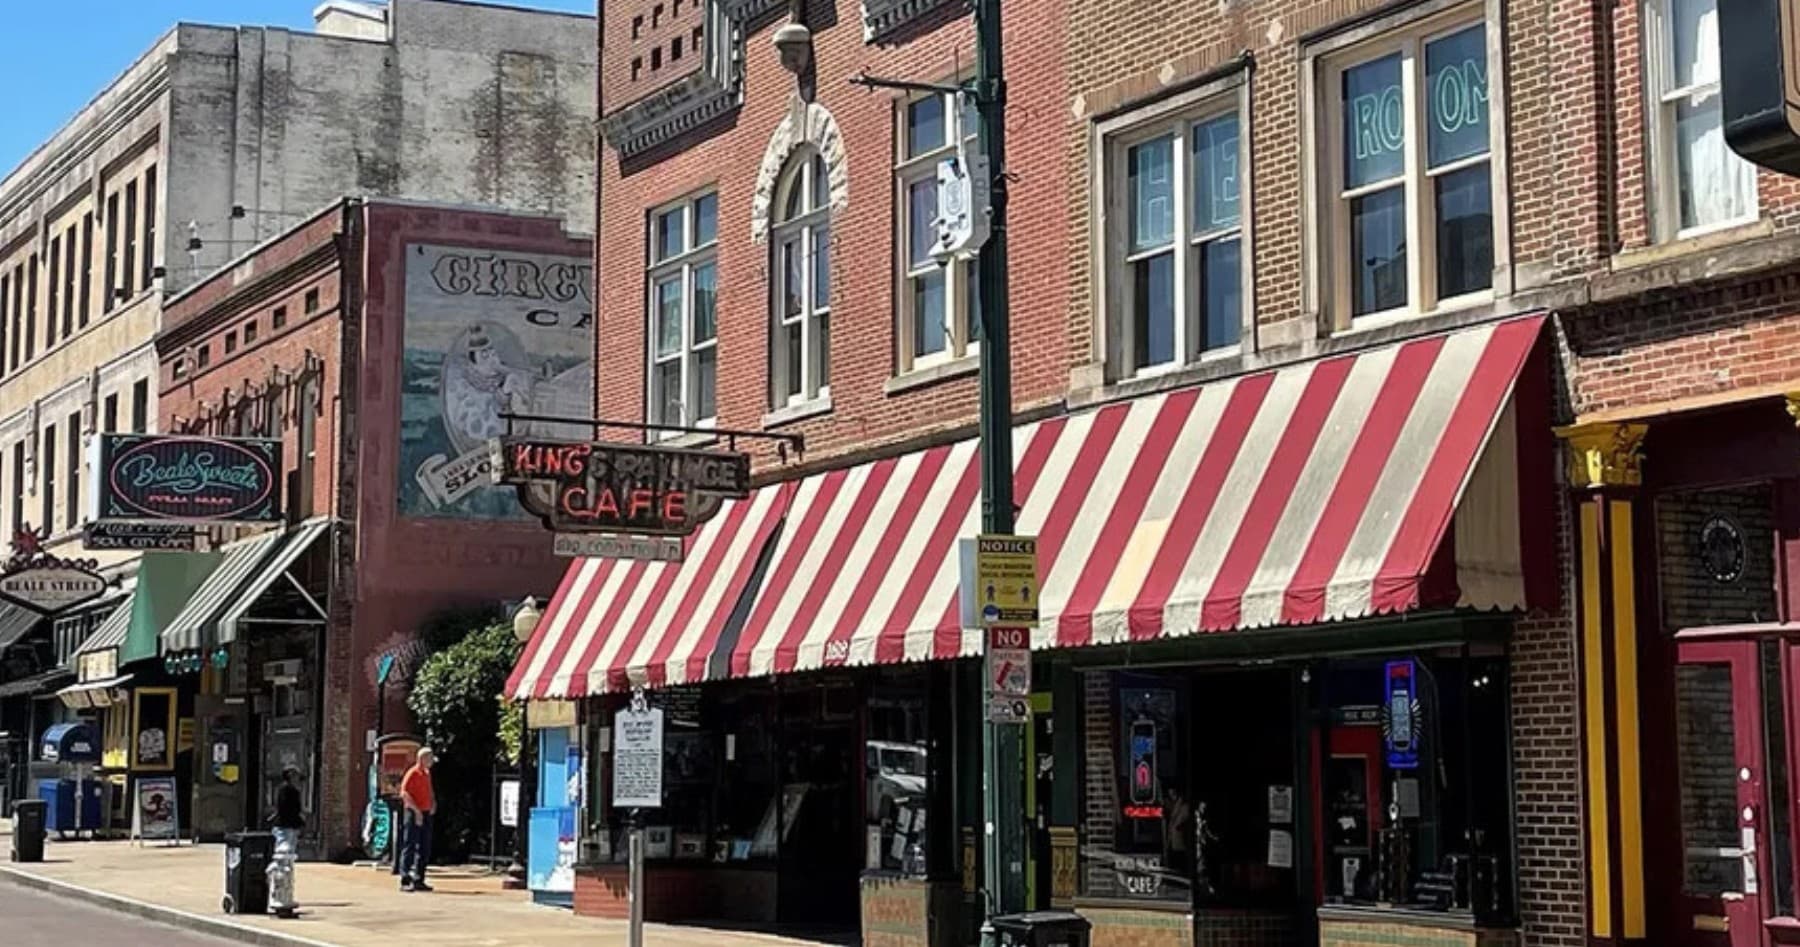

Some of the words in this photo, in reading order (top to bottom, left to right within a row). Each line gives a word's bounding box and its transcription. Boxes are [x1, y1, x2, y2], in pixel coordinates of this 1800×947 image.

[562, 486, 688, 521] CAFE
[981, 541, 1033, 552] NOTICE
[5, 581, 45, 591] BEALE
[50, 581, 97, 591] STREET
[997, 628, 1023, 647] NO
